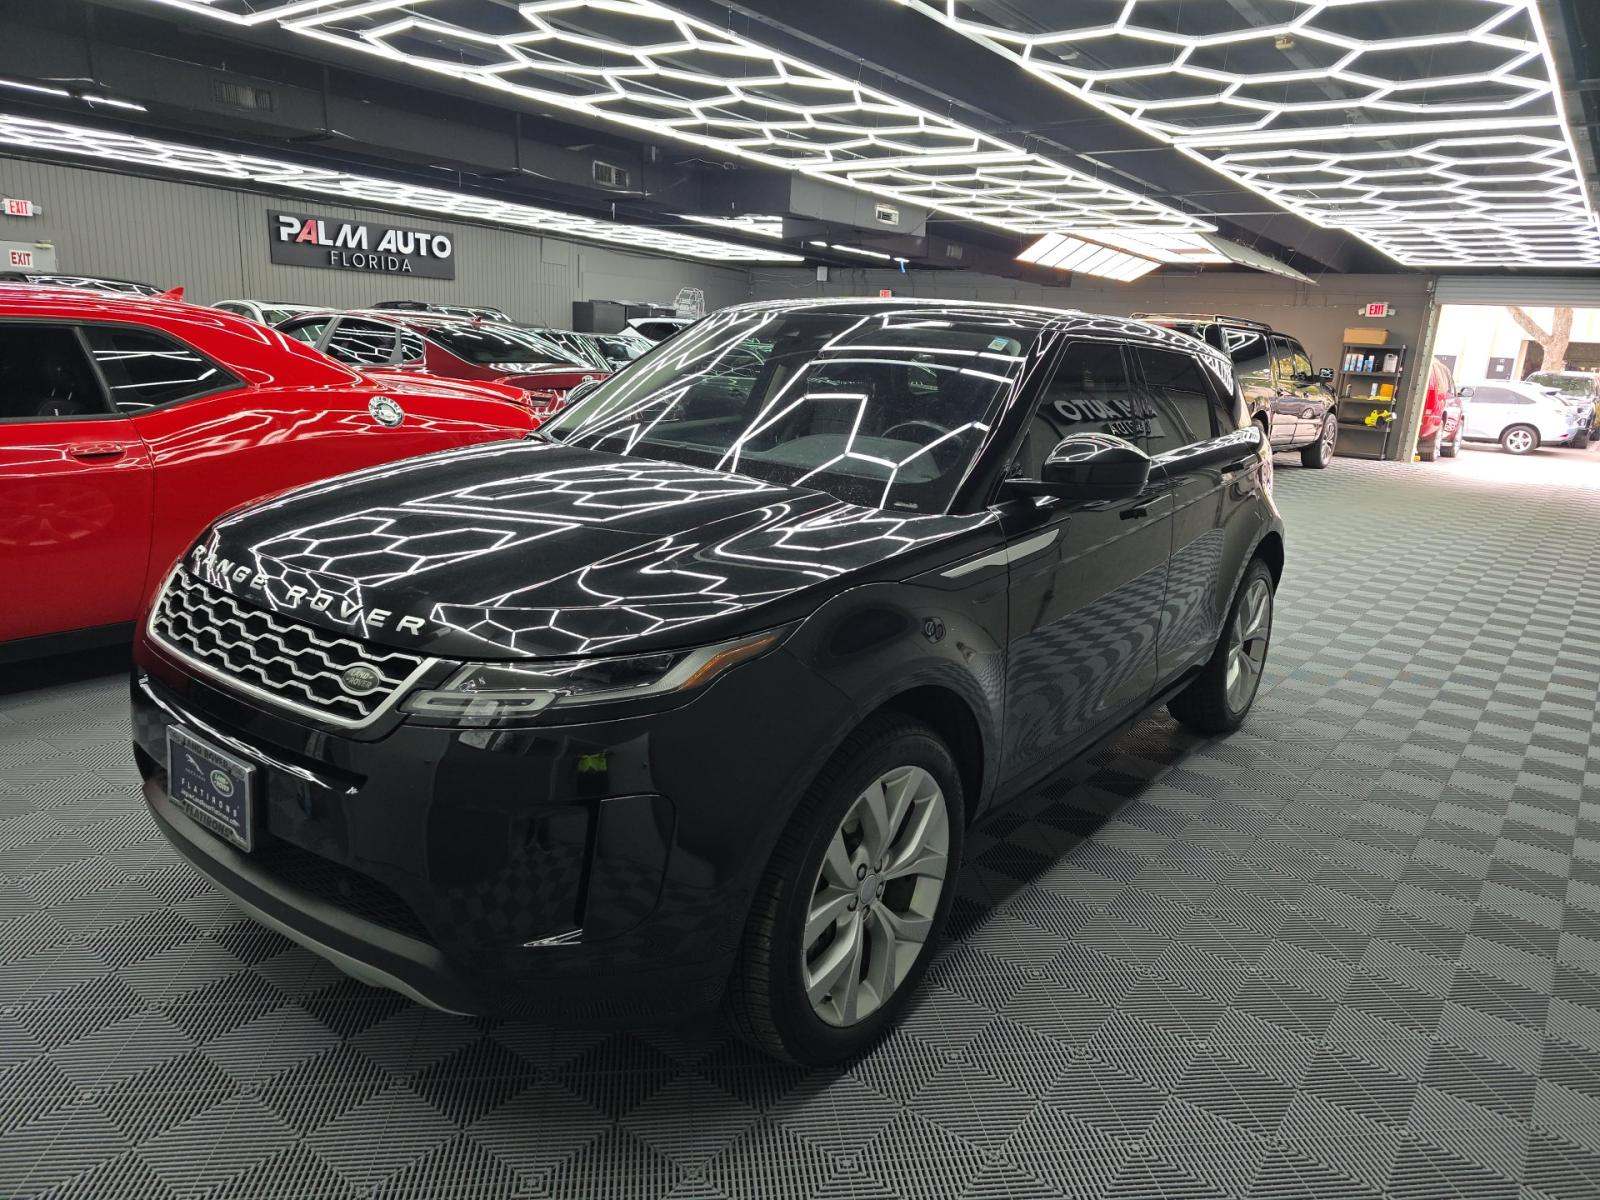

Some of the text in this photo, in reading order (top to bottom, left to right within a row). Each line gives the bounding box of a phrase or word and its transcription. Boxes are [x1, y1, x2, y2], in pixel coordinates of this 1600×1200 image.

[9, 201, 28, 214] EXIT
[278, 215, 452, 259] PALM AUTO
[10, 251, 31, 265] EXIT
[330, 250, 412, 273] FLORIDA
[1369, 304, 1384, 315] EXIT
[191, 544, 426, 636] RANGE ROVER
